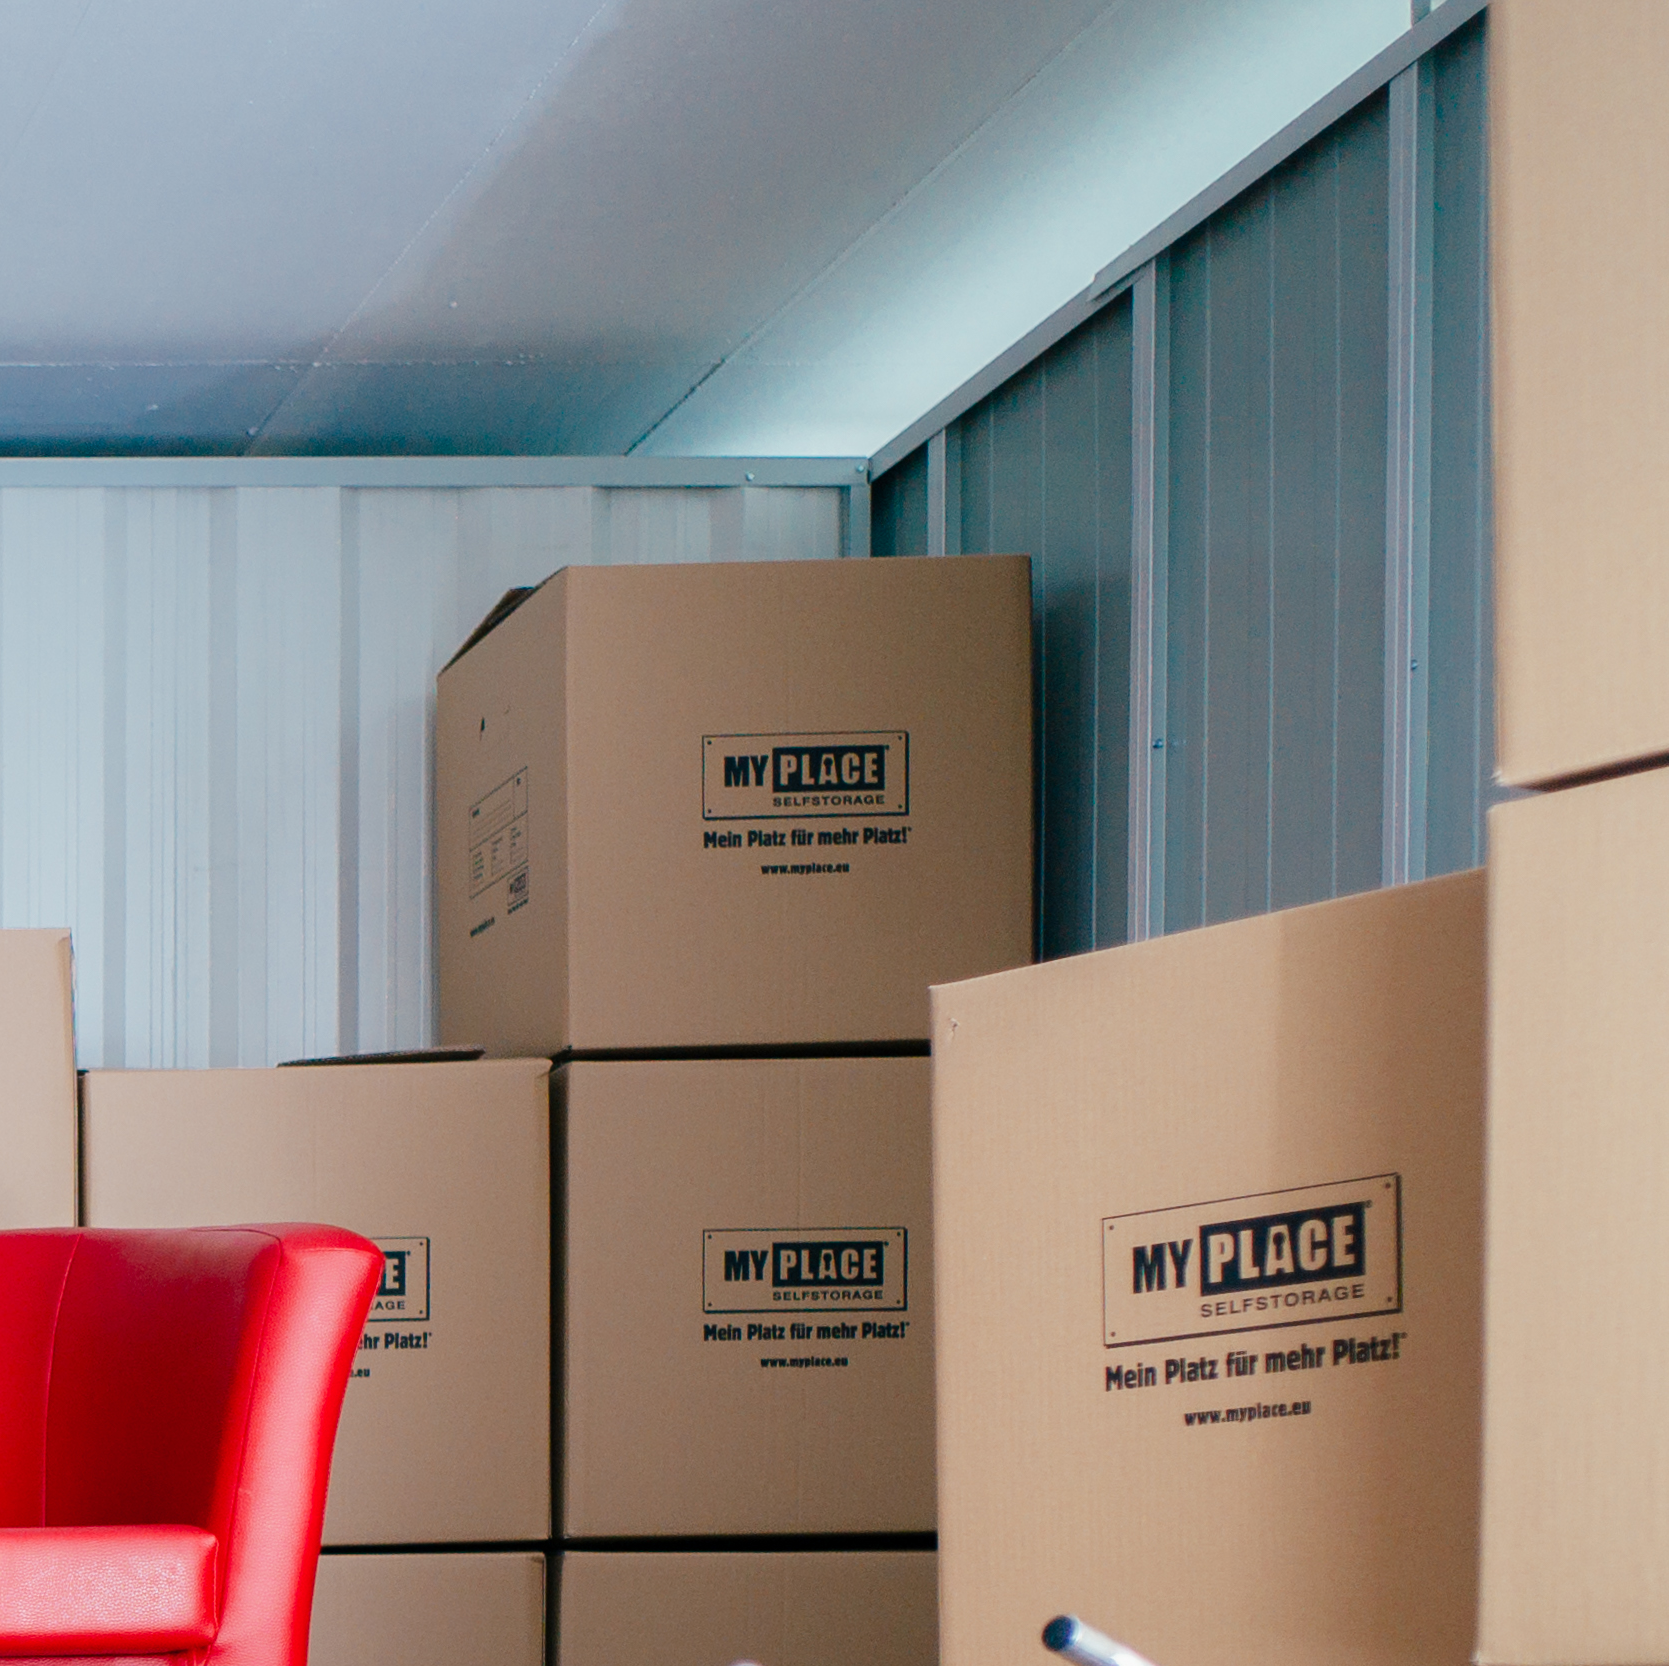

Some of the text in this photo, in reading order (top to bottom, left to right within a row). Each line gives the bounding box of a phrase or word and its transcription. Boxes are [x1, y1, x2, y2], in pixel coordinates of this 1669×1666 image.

[724, 752, 879, 787] MY PLACE
[772, 795, 885, 807] SELFSTORAGE
[703, 826, 907, 848] Mein Platz für mehr Platz!
[760, 862, 850, 874] www.myplace.eu
[724, 1248, 878, 1281] MY PLACE
[1132, 1214, 1356, 1294] MY PLACE
[772, 1290, 884, 1301] SELFSTORAGE
[1200, 1283, 1365, 1318] SELFSTORAGE
[384, 1332, 428, 1349] Platz!
[703, 1321, 906, 1341] Mein Platz für mehr Platz!
[760, 1356, 849, 1368] www.myplace.eu
[1105, 1332, 1401, 1392] Mein Platz für mehr Platz!
[1184, 1400, 1312, 1426] www.myplace.eu
